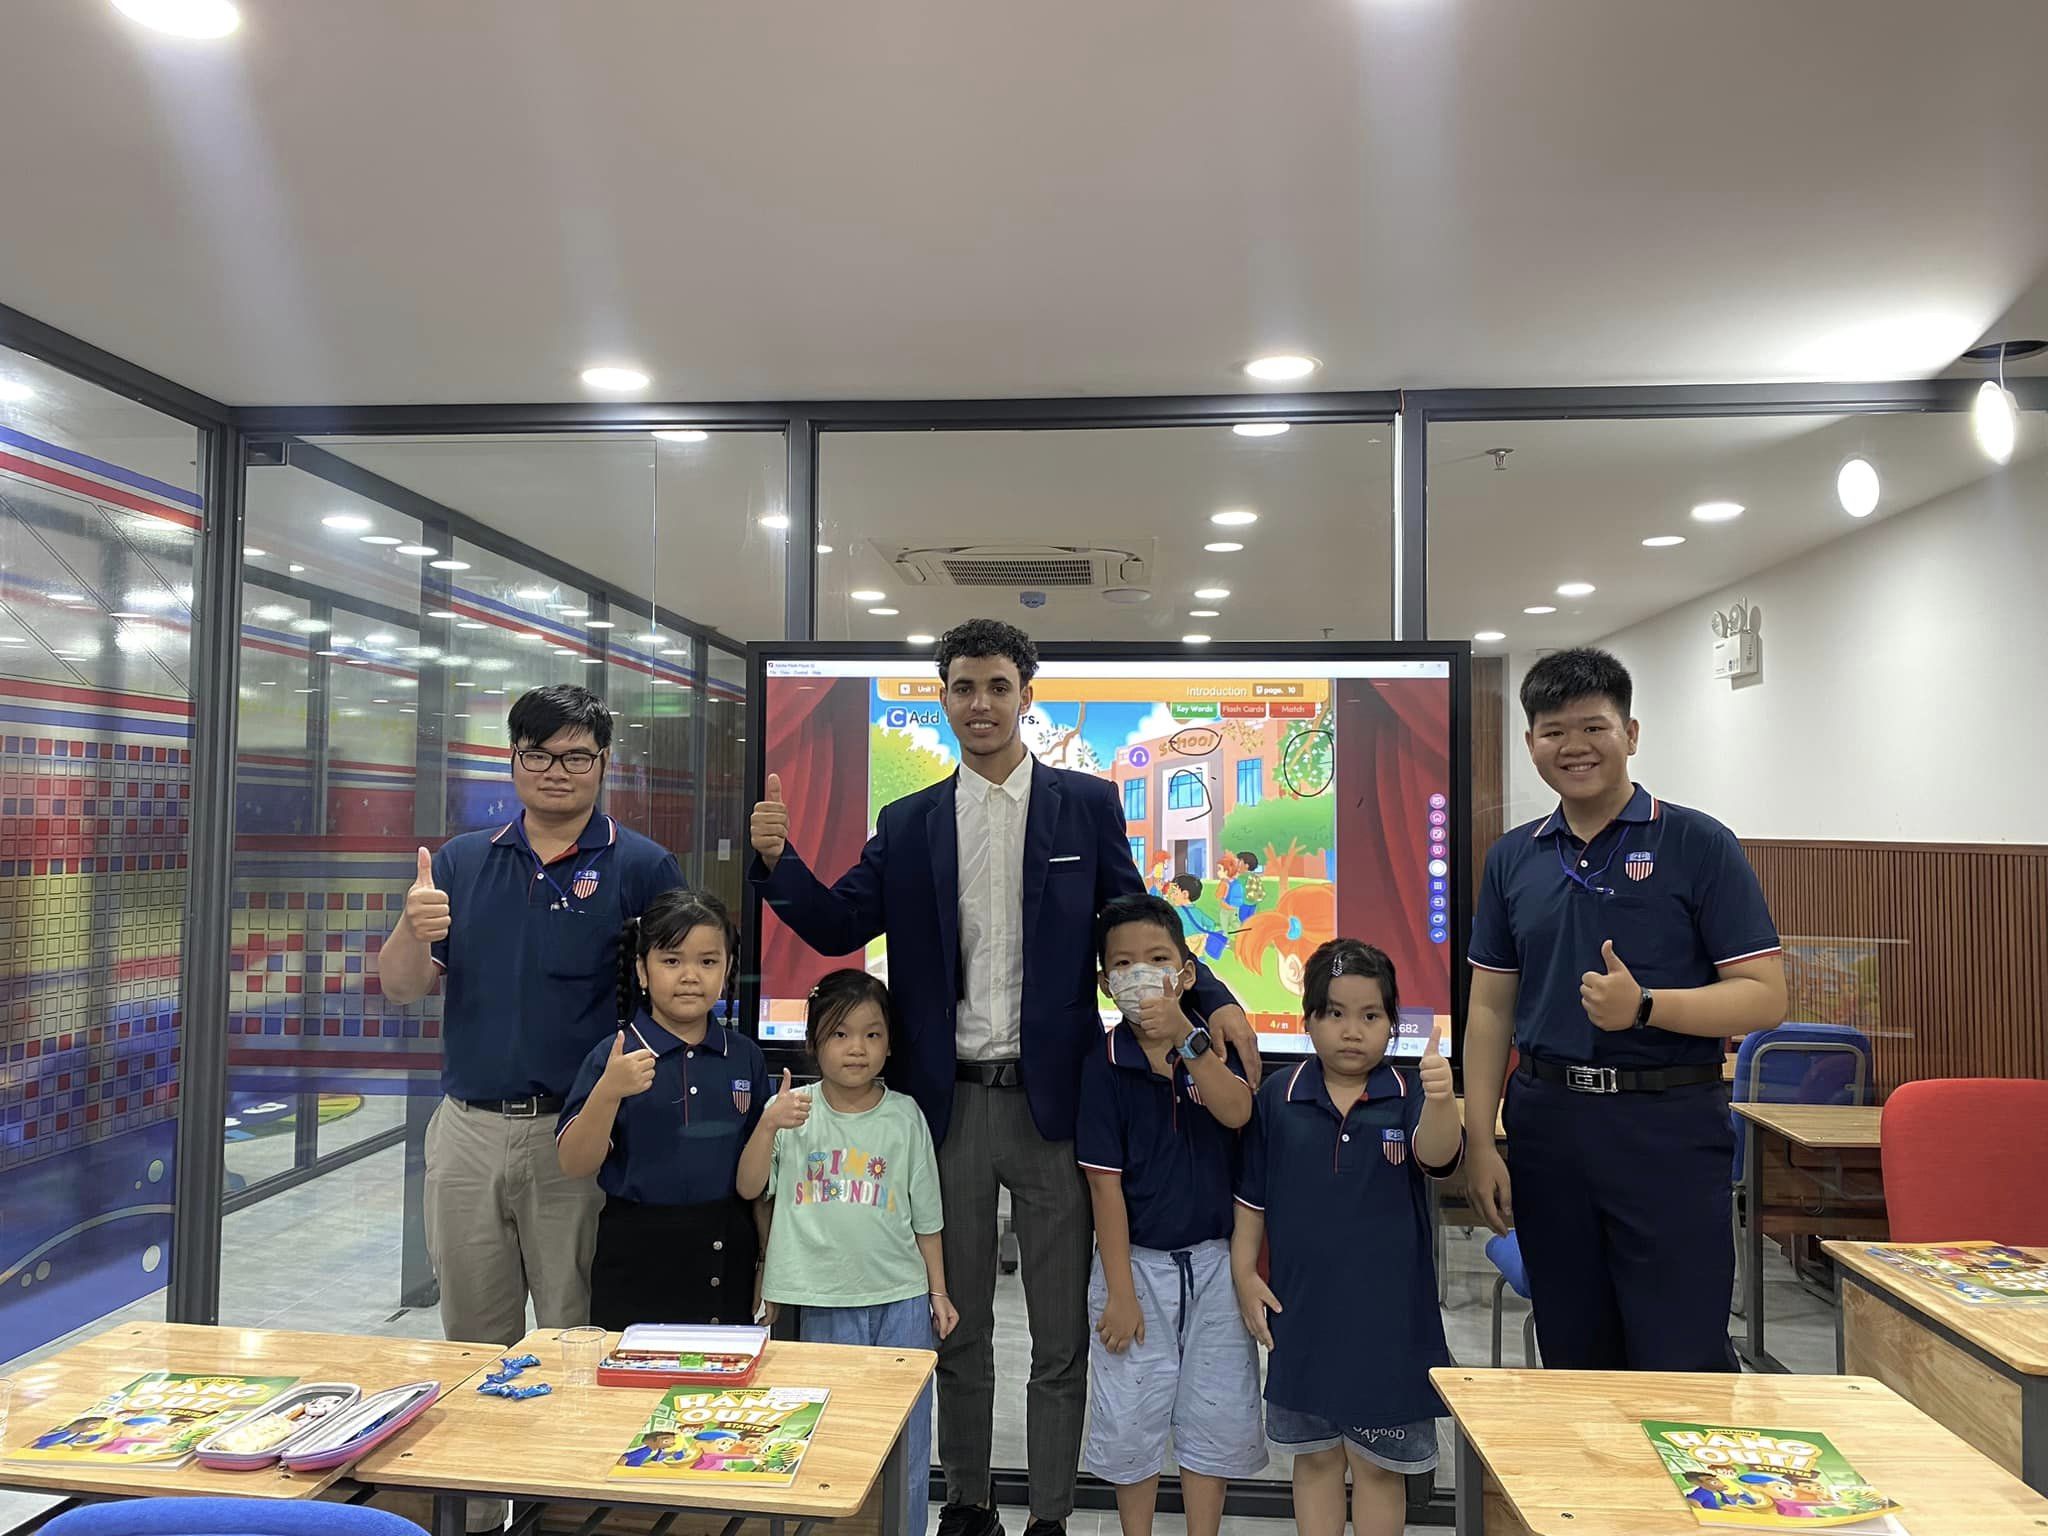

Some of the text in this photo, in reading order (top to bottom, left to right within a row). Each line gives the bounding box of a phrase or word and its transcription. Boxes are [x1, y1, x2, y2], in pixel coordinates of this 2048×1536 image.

[917, 685, 932, 693] Unit
[1186, 687, 1247, 697] Introduction
[1288, 686, 1297, 694] 10
[1176, 705, 1214, 714] Key Words
[1222, 705, 1264, 713] Flash Cards
[1281, 705, 1305, 713] Match
[909, 711, 940, 724] Add
[136, 1381, 264, 1398] HANG
[129, 1394, 235, 1411] OUT!
[679, 1394, 803, 1411] HANG
[682, 1408, 785, 1426] OUT!
[724, 1421, 771, 1432] STARTER
[1667, 1431, 1815, 1457] HANG
[1695, 1446, 1810, 1472] OUT!
[1755, 1465, 1813, 1479] STARTER
